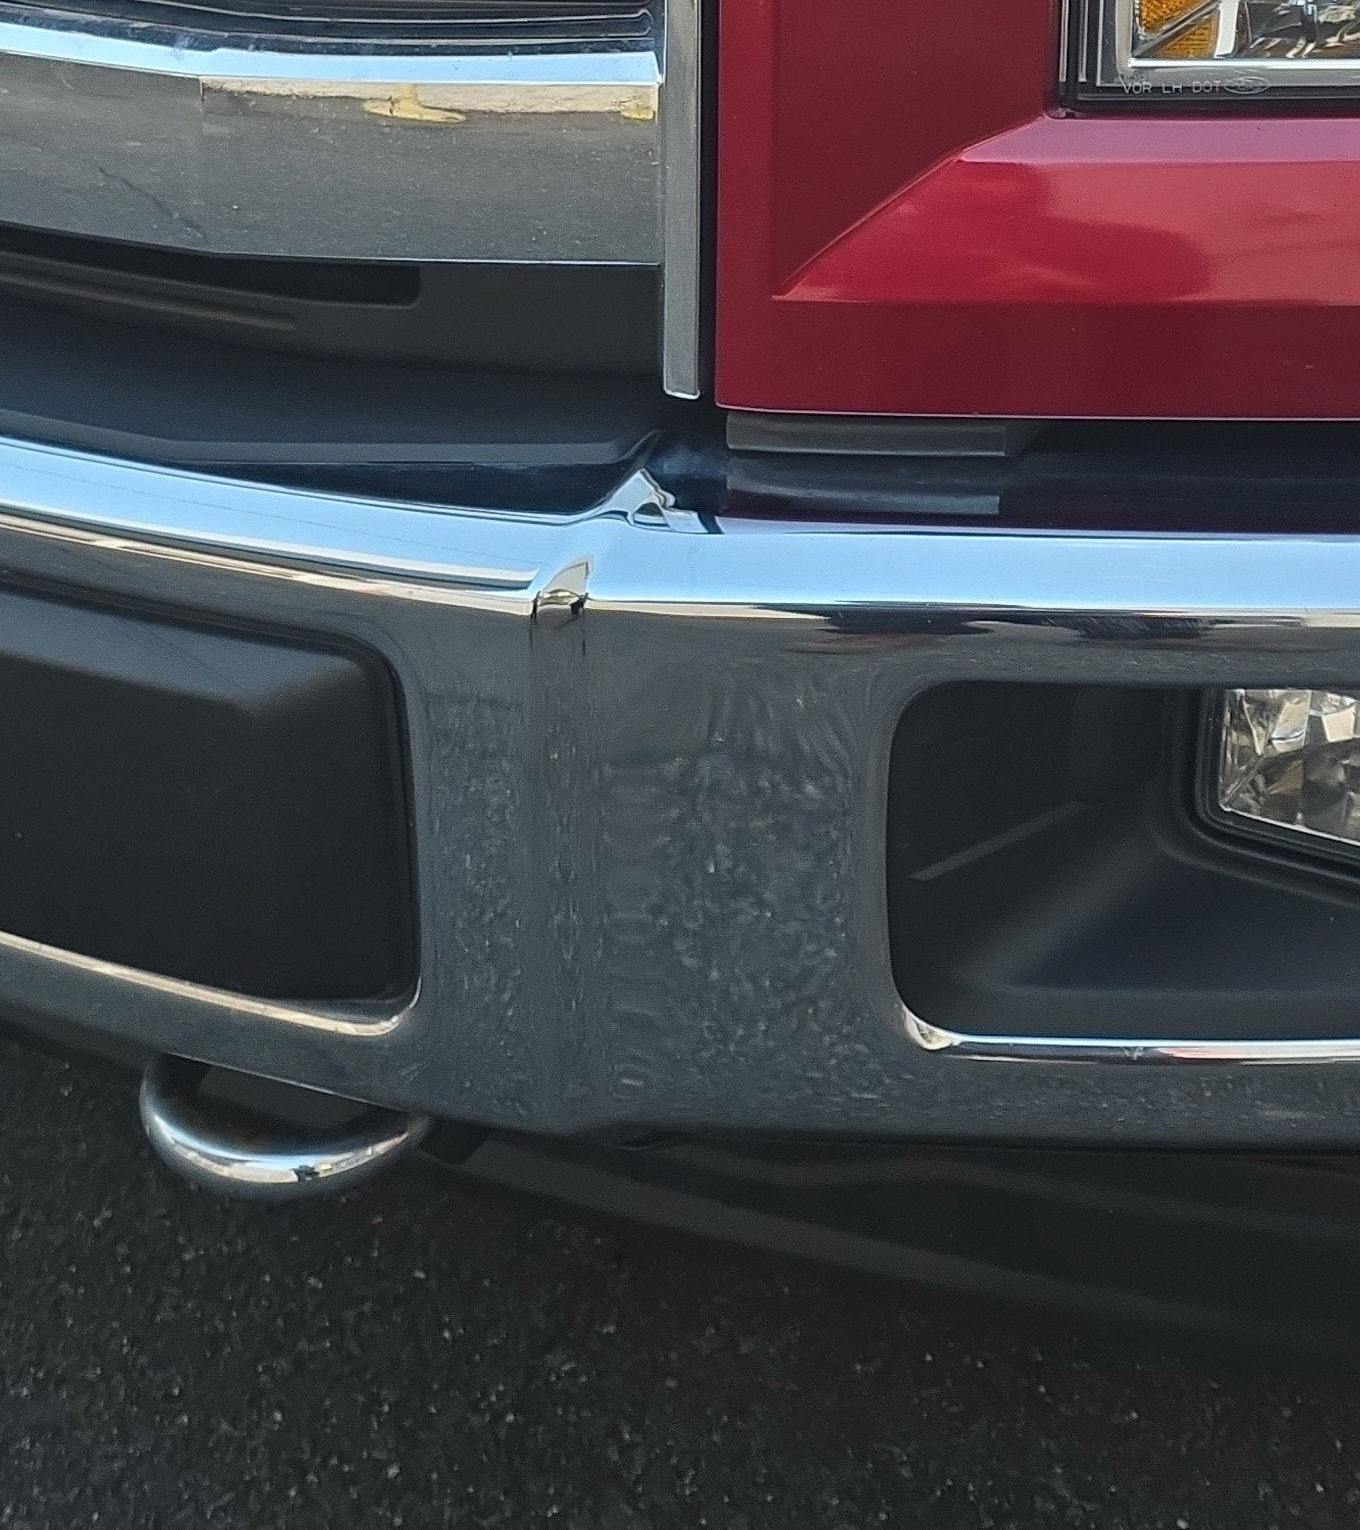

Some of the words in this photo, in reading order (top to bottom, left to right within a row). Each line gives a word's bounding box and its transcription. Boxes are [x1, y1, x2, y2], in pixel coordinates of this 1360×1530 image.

[1121, 81, 1153, 95] VOR
[1162, 81, 1184, 94] LH
[1192, 80, 1222, 93] DOT
